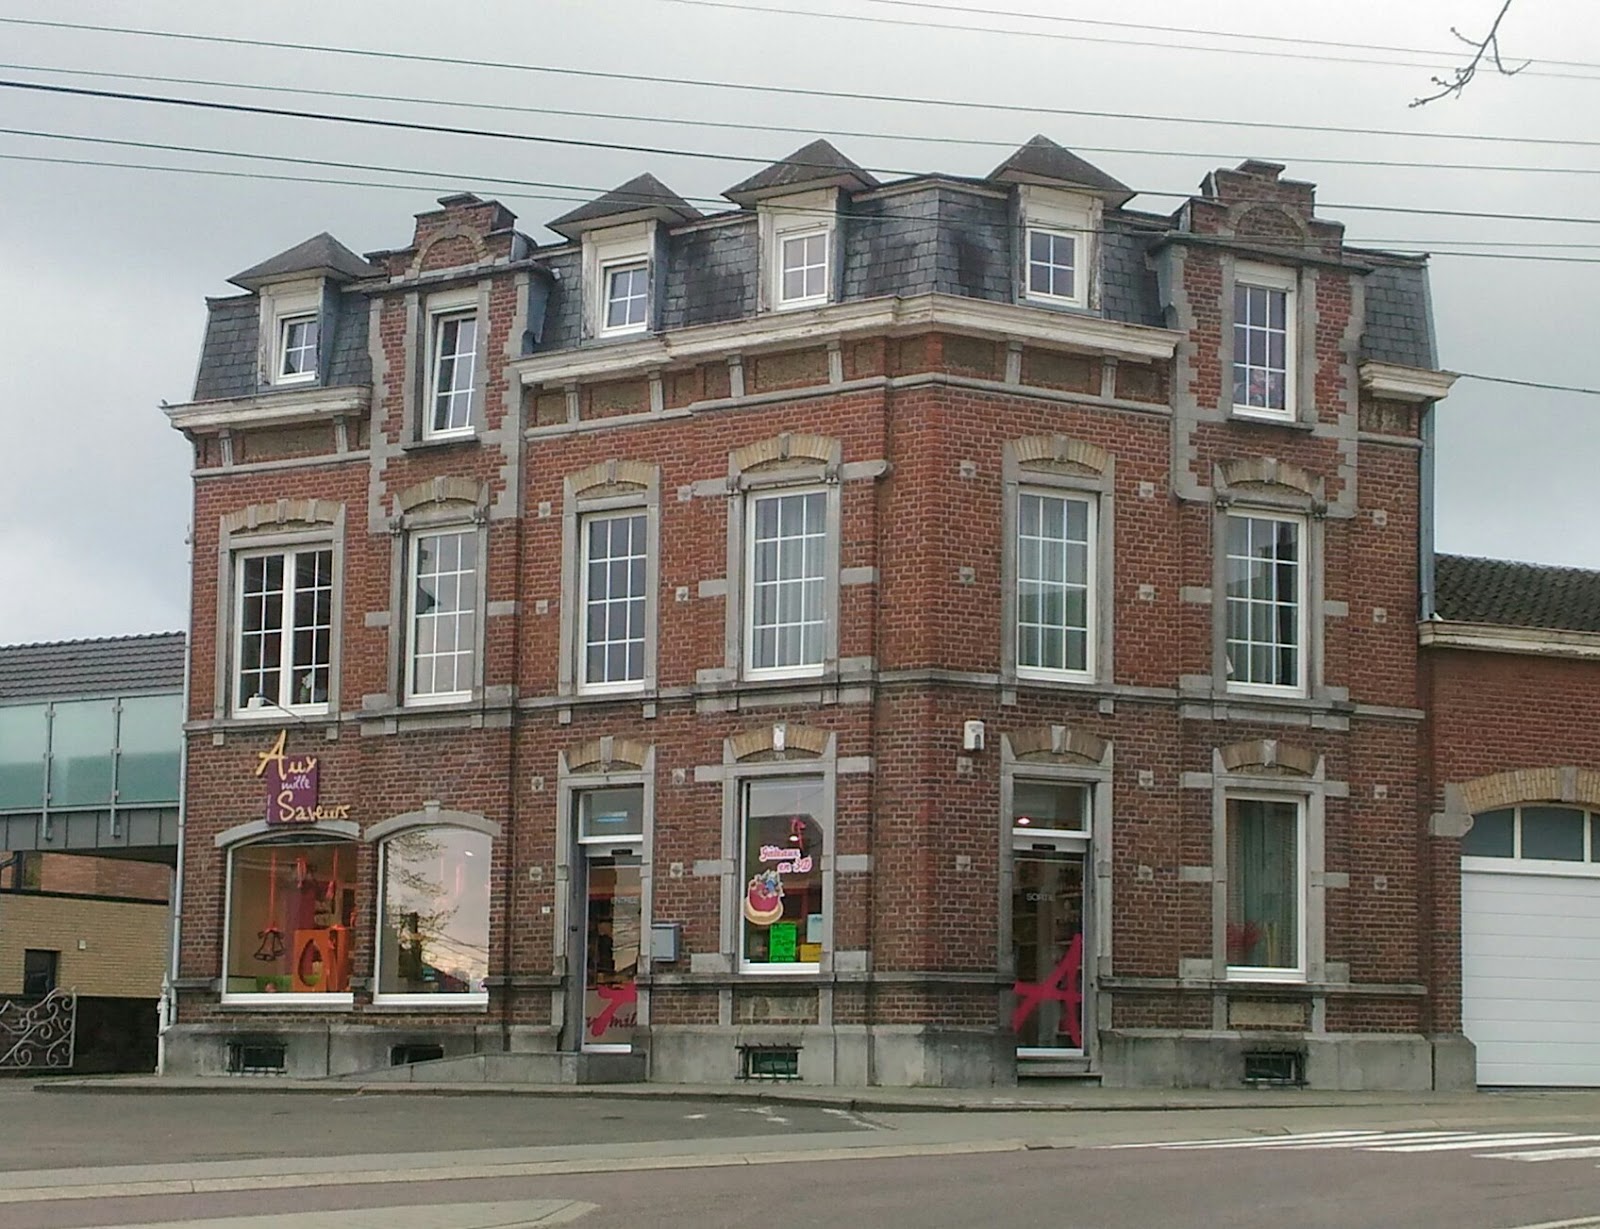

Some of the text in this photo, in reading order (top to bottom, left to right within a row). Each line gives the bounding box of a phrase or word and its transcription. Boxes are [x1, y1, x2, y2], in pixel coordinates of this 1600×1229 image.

[256, 728, 317, 780] Aux
[281, 775, 311, 790] mille
[277, 790, 350, 822] Saveurs
